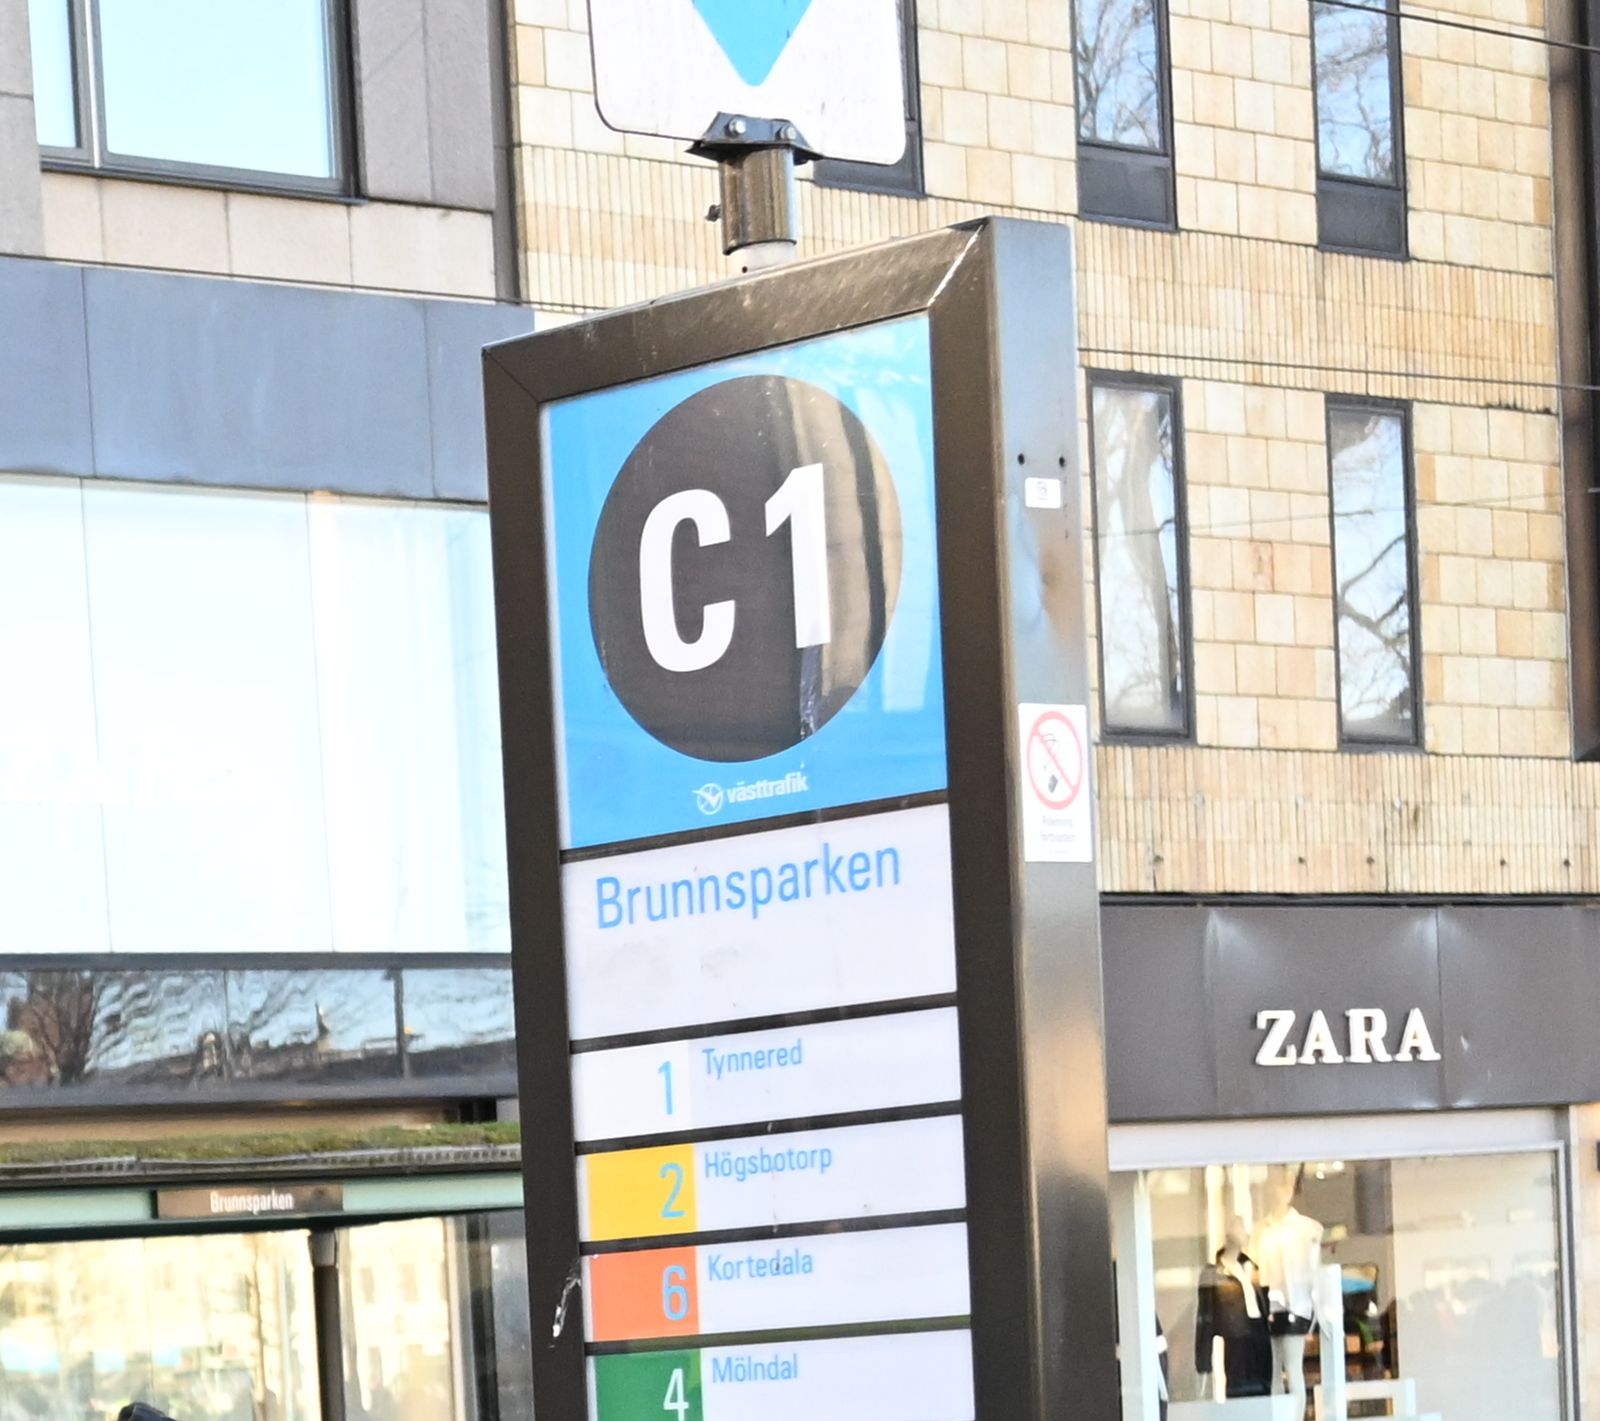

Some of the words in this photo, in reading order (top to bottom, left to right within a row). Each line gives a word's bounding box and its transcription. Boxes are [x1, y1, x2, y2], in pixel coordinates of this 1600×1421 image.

[639, 463, 833, 673] C1
[727, 771, 809, 803] västtrafik
[596, 843, 900, 929] Brunnsparken
[703, 1039, 802, 1080] Tynnered
[1254, 1007, 1440, 1066] ZARA
[658, 1060, 673, 1115] 1
[659, 1162, 685, 1218] 2
[705, 1146, 832, 1182] Högsbotorp
[210, 1187, 293, 1215] Brunnsparken
[708, 1249, 813, 1281] Kortedala
[662, 1265, 688, 1321] 6
[664, 1368, 689, 1421] 4
[712, 1353, 799, 1384] Mölndal
